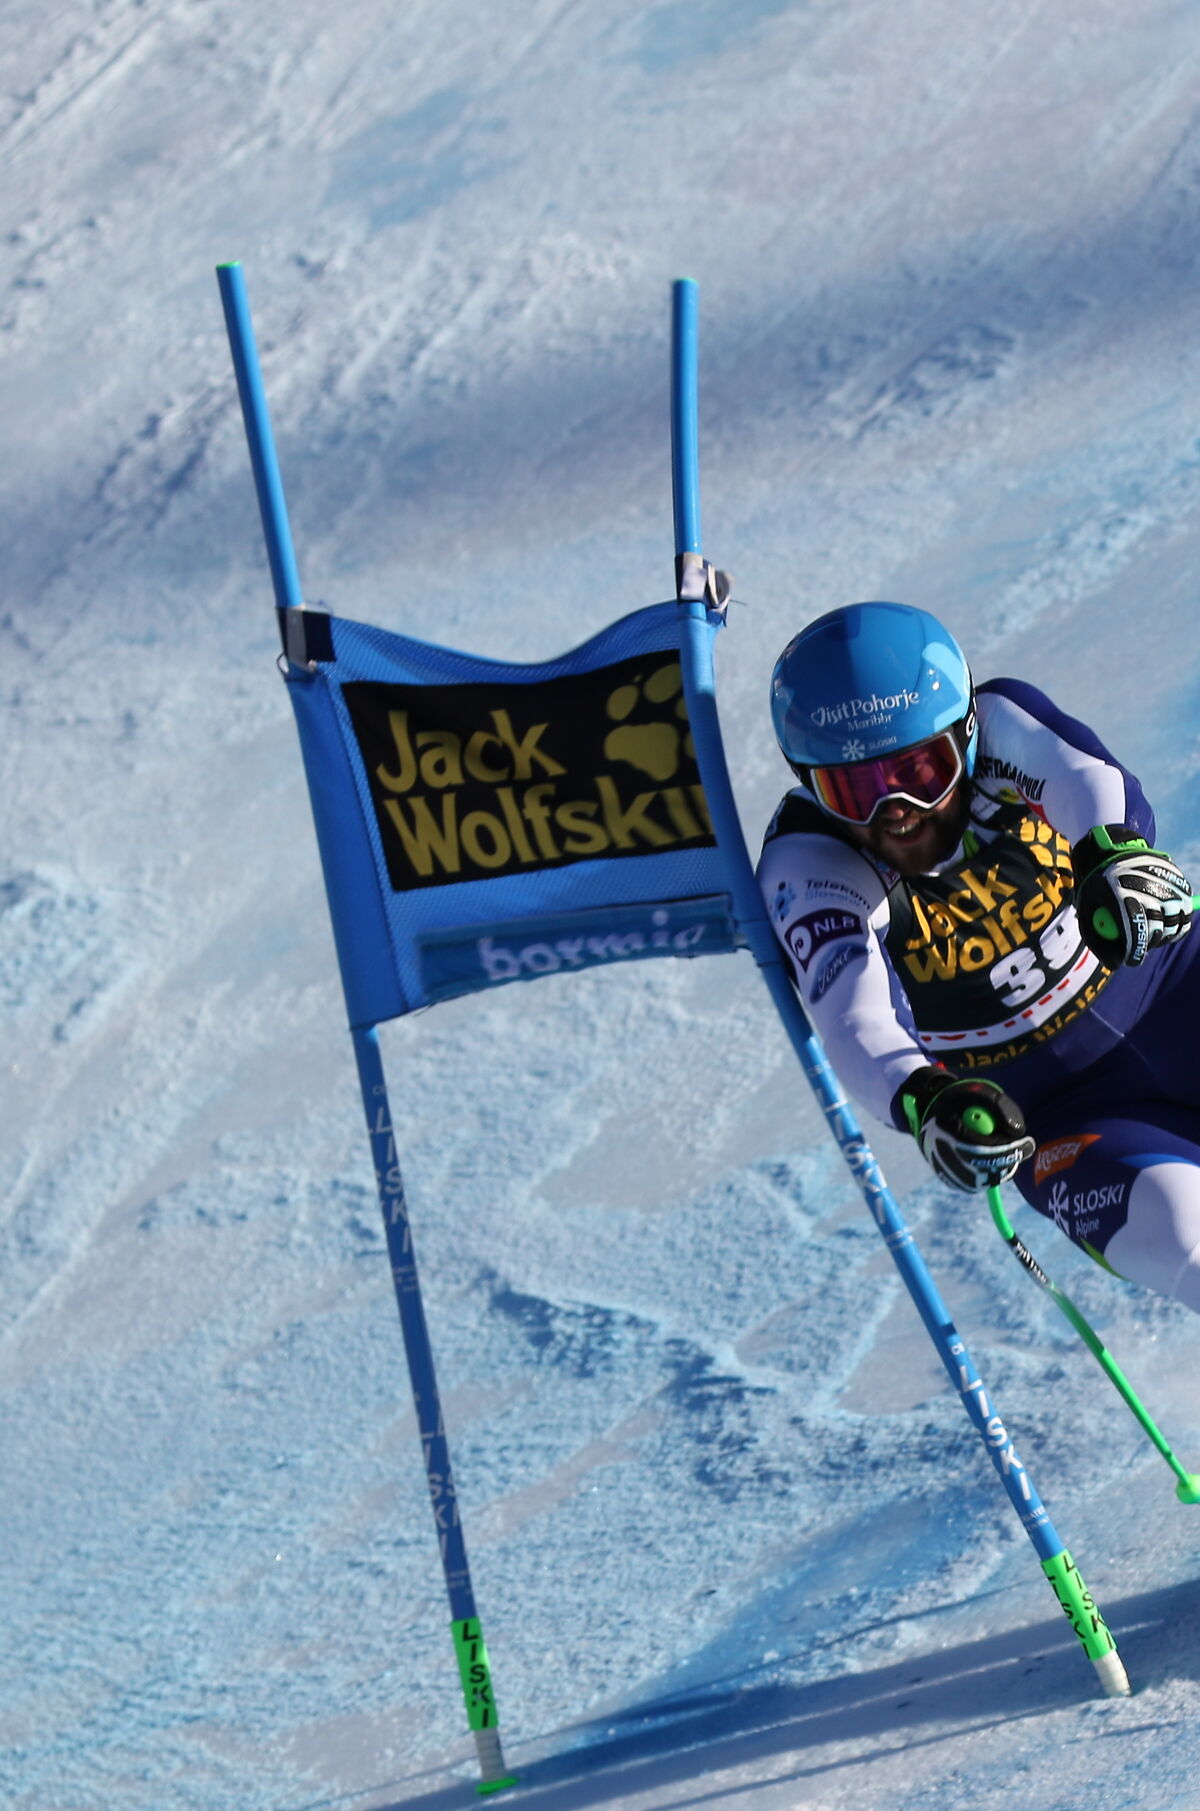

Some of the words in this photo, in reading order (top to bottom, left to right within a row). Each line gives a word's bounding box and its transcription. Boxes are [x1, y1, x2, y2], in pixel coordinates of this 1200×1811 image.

[375, 709, 567, 793] Jack
[384, 775, 714, 877] Wolfski
[805, 879, 871, 911] Telekom
[813, 916, 856, 937] NLB
[905, 864, 1019, 951] Jack
[1133, 911, 1147, 961] reusch
[971, 1148, 1023, 1169] reusch
[1074, 1183, 1125, 1217] SLOSKI
[1076, 1218, 1100, 1238] Alpine
[959, 1365, 1031, 1500] LISKI
[1062, 1554, 1113, 1650] LISKI
[461, 1621, 490, 1729] LISKI
